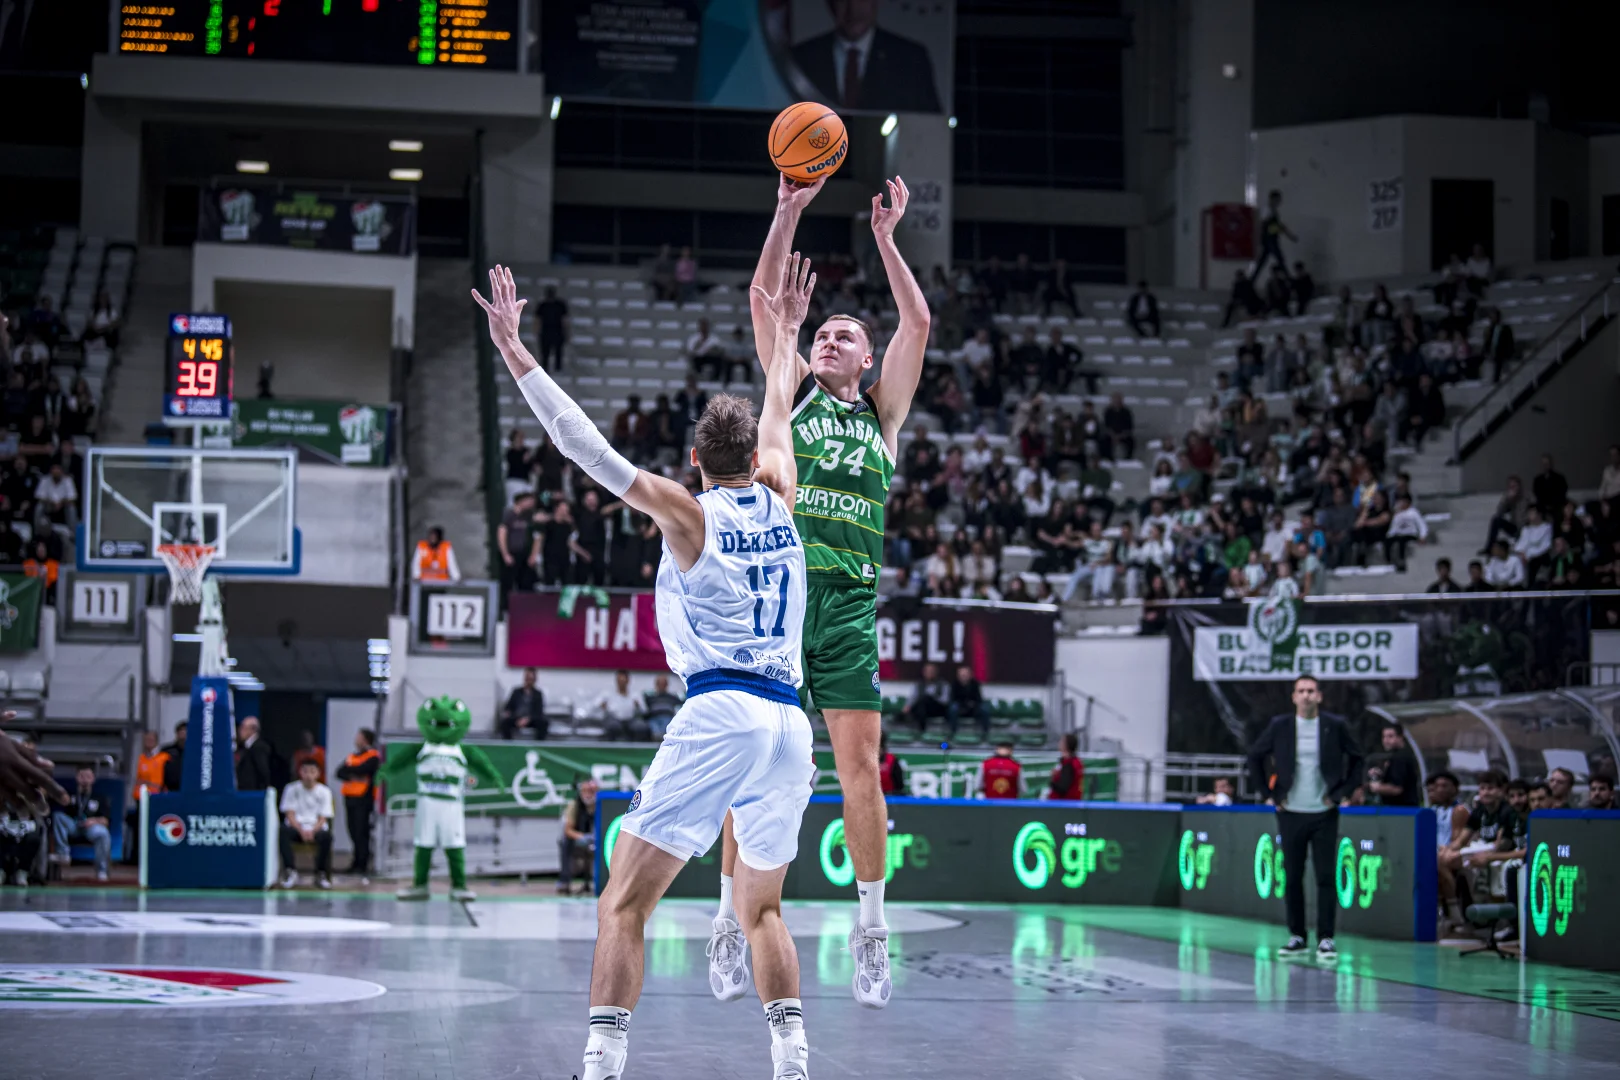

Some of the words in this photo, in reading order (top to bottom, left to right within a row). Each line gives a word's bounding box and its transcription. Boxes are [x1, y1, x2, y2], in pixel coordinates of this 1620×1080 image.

[183, 338, 197, 360] 4
[200, 338, 223, 361] 45
[176, 361, 218, 397] 39
[819, 438, 867, 477] 34
[795, 487, 872, 519] BURTOM
[831, 510, 858, 522] GRUBU
[719, 525, 797, 553] DEKKER
[84, 586, 119, 616] 111
[745, 563, 790, 637] 17
[437, 602, 476, 630] 112
[1218, 630, 1392, 651] BUASPOR
[1220, 654, 1389, 673] BAETBOL
